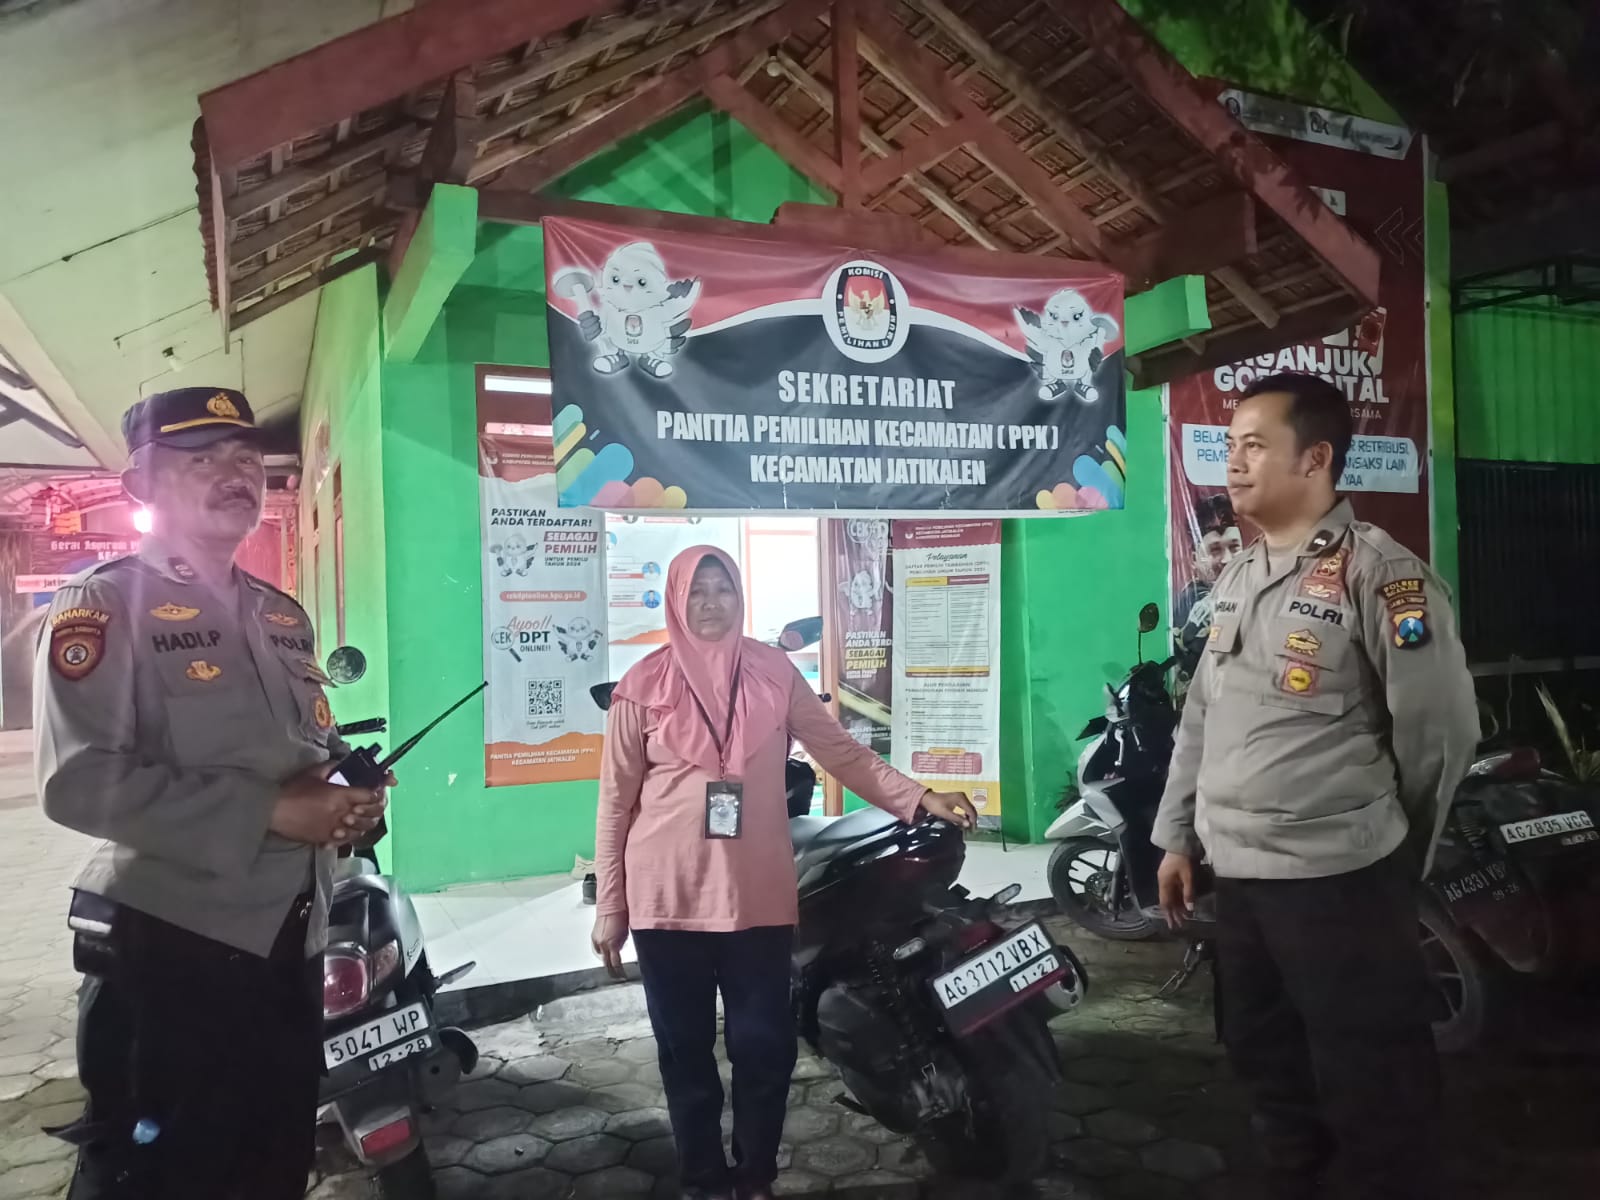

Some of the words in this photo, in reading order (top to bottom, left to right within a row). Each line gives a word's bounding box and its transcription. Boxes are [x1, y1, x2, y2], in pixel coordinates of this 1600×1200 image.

[847, 268, 884, 280] KOMISI
[777, 369, 956, 410] SEKRETARIAT
[656, 410, 750, 443] PANITIA
[753, 415, 870, 447] PEMILIHAN
[874, 419, 994, 449] KECAMATAN
[750, 454, 882, 485] KECAMATAN
[886, 457, 987, 486] JATIKALEN
[491, 507, 547, 518] PASTIKAN
[491, 517, 525, 526] ANDA
[527, 518, 593, 528] TERDAFTAR!
[546, 532, 595, 542] SEBAGAI
[544, 544, 598, 554] PEMILIH
[1288, 600, 1344, 626] POLRI
[519, 631, 551, 644] DPT
[943, 974, 969, 1004] AG
[966, 951, 1012, 988] 3712
[1007, 930, 1046, 964] VBX
[329, 1024, 384, 1062] 5047
[393, 1010, 420, 1036] WP
